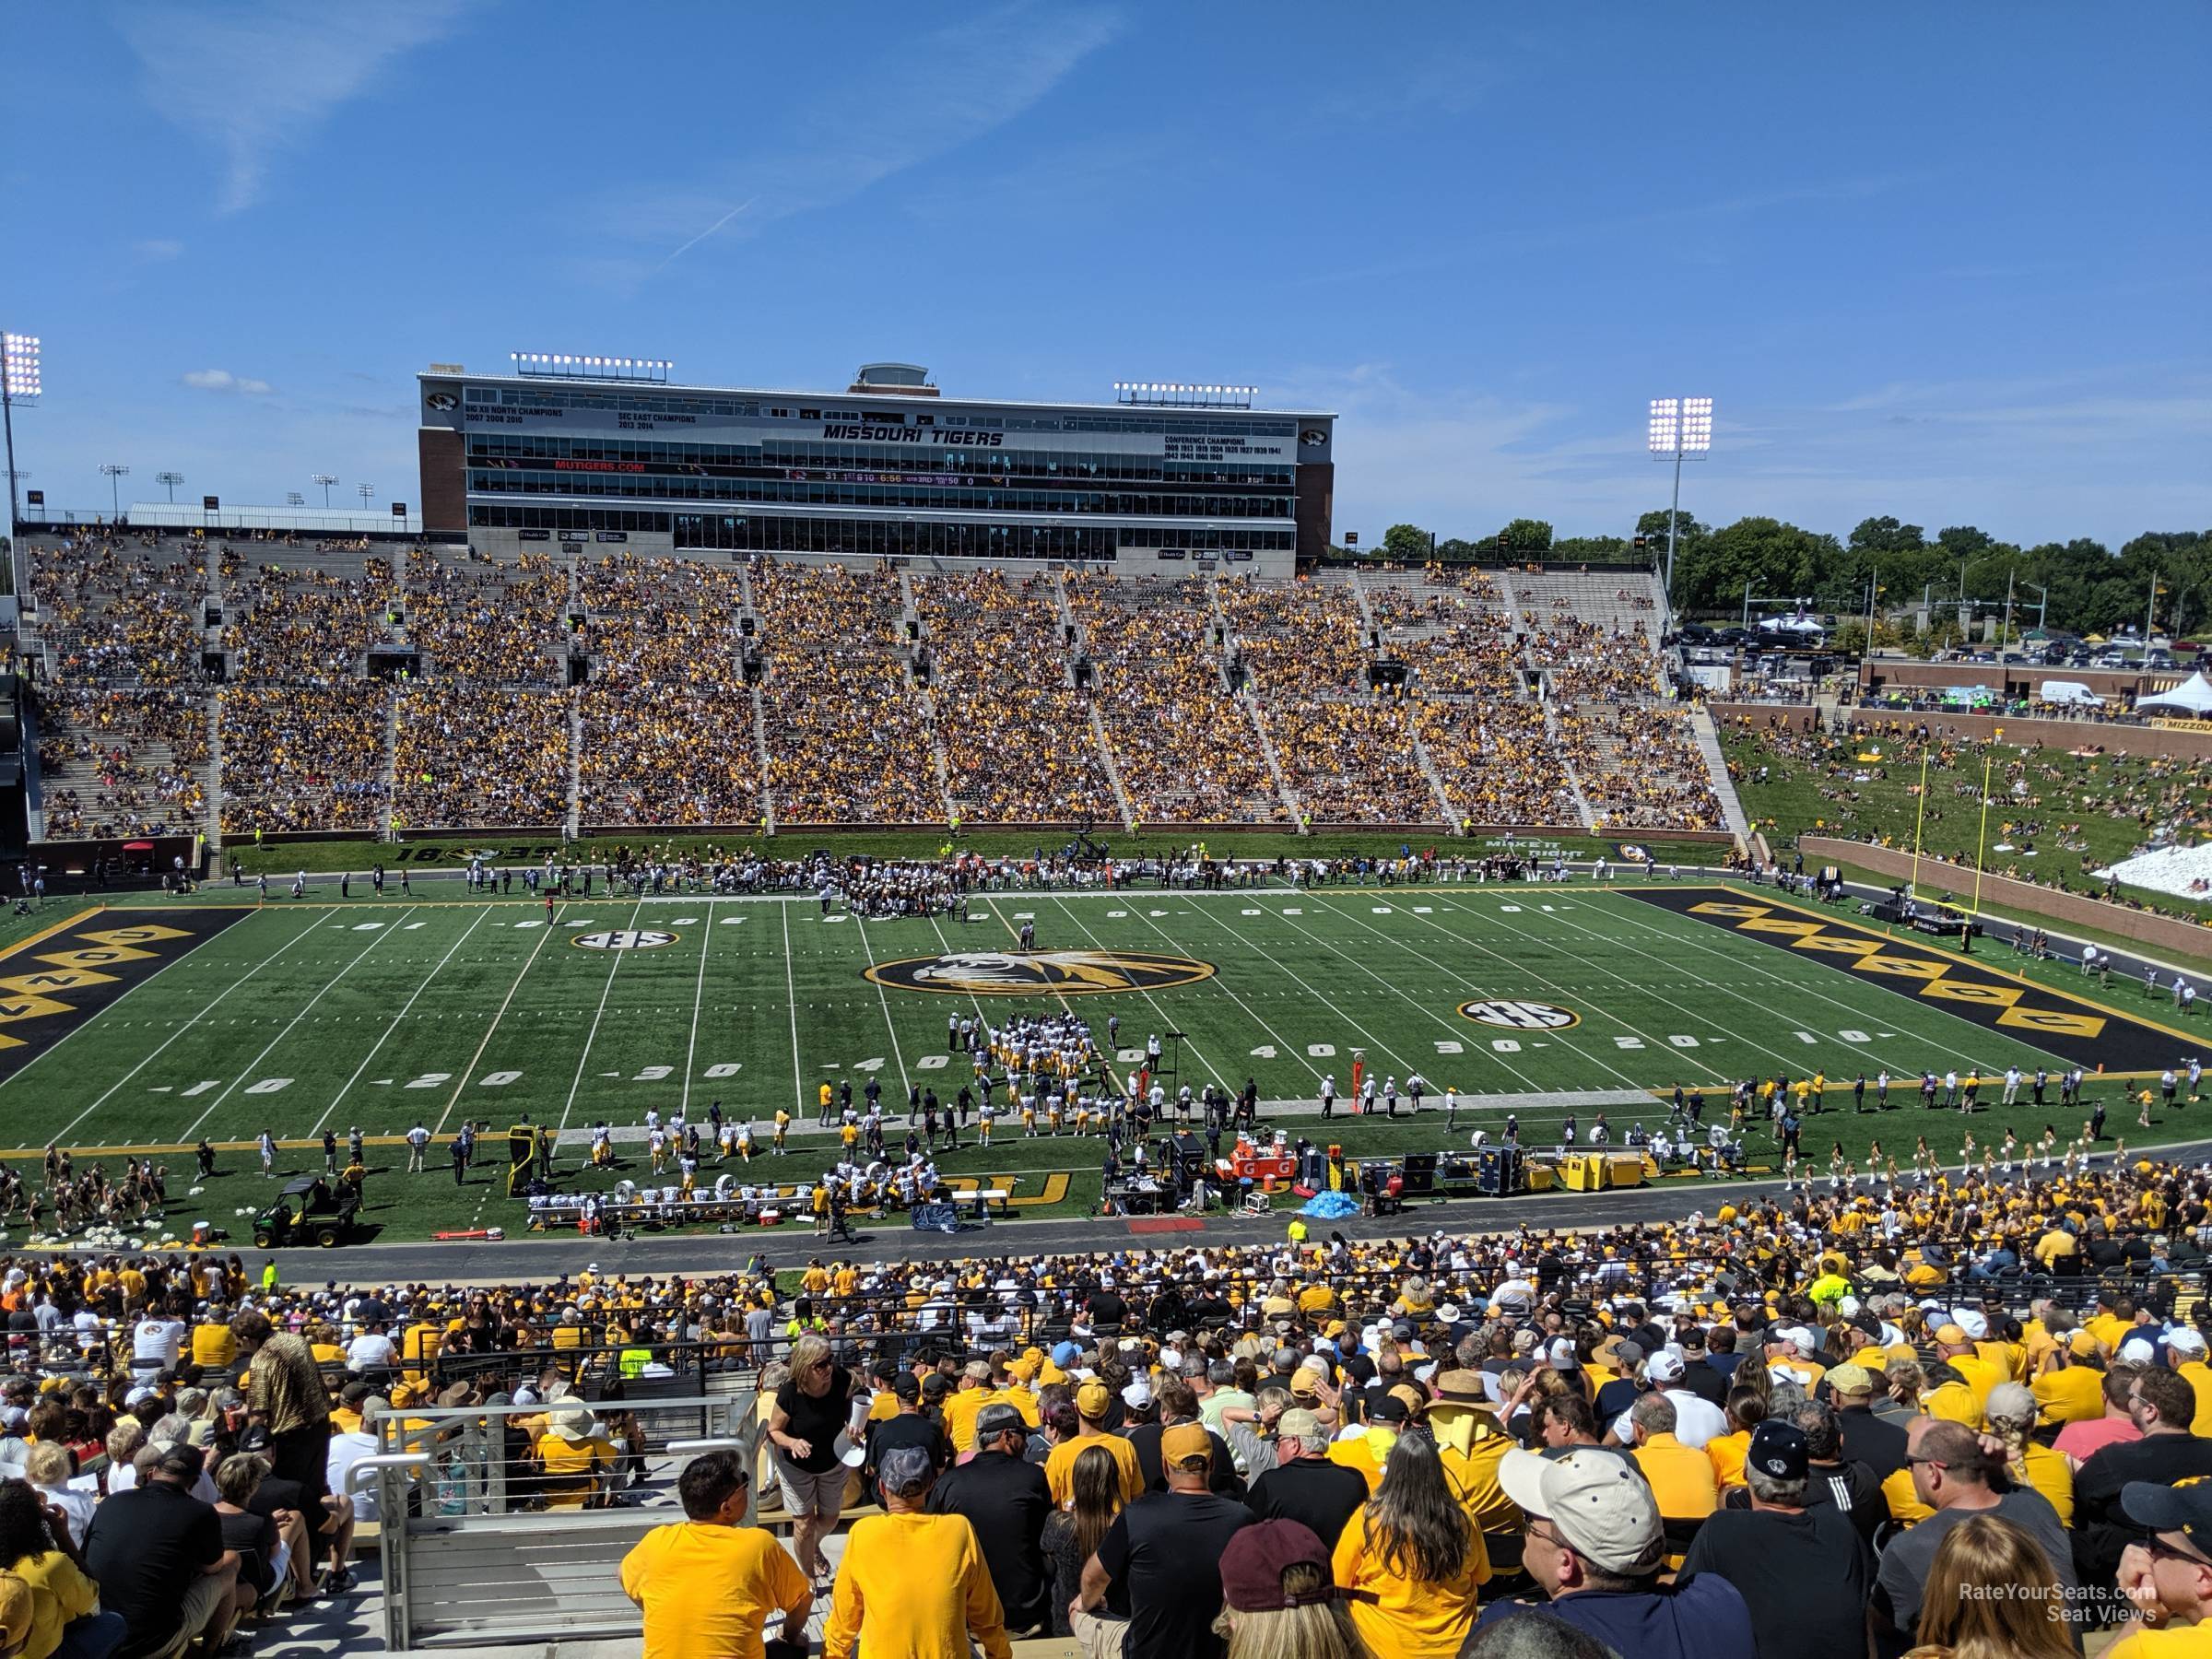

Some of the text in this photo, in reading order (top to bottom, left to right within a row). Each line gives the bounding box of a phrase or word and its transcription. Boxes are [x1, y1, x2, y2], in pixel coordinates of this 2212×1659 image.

[491, 406, 516, 415] NORTH
[518, 407, 563, 417] CHAMPIONS
[506, 416, 523, 424] 2010
[618, 412, 696, 423] SEC EAST CHAMPIONS
[637, 421, 653, 429] 2014
[824, 425, 1003, 446] MISSOURI TIGERS
[1164, 436, 1206, 444] CONFERENCE
[555, 461, 644, 473] MUTIGERS.COM
[826, 472, 836, 480] 31
[880, 475, 901, 483] 6:56
[2168, 722, 2212, 731] MIZZOU
[1243, 1162, 1254, 1174] G
[1279, 1161, 1289, 1173] G
